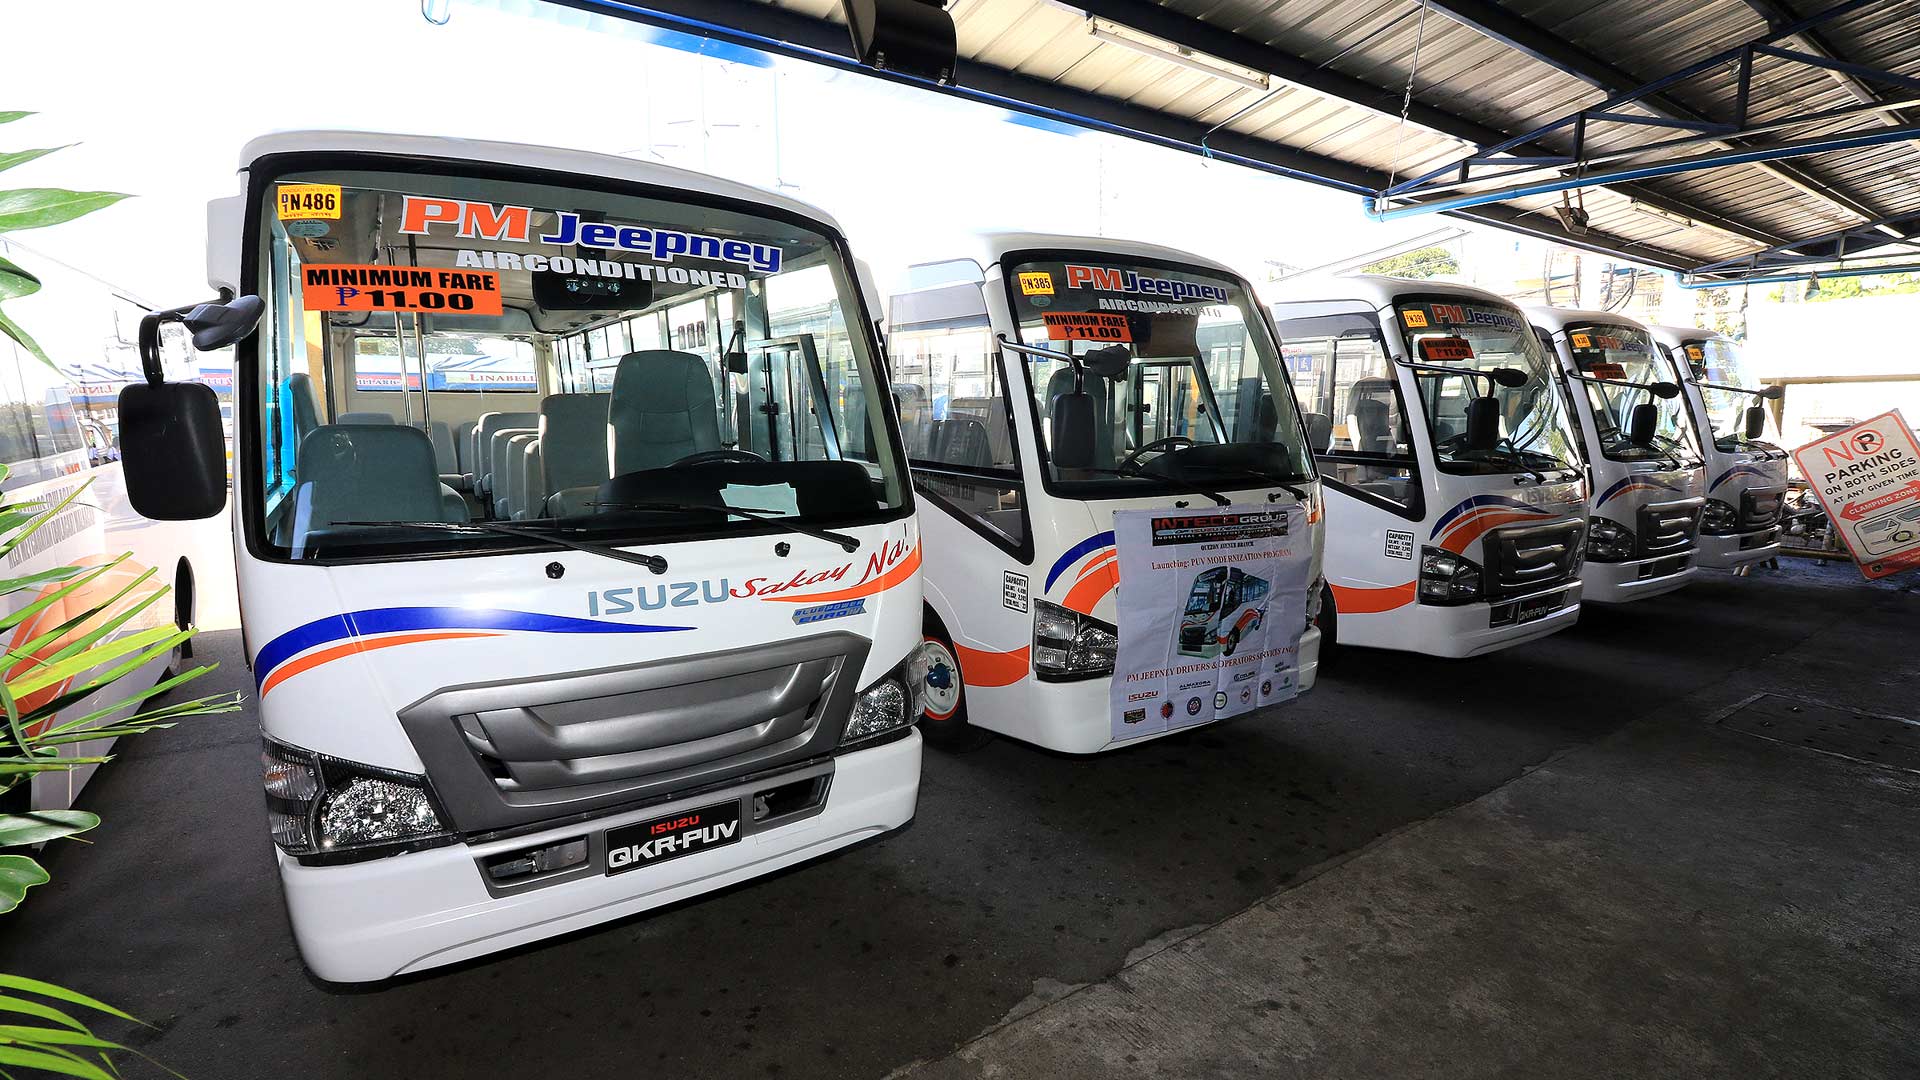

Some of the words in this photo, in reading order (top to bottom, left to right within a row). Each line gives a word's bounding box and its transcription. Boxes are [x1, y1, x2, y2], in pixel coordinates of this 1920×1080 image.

[399, 195, 533, 242] PM
[540, 211, 783, 274] Jeepney
[307, 269, 432, 288] MINIMUM
[439, 272, 495, 290] FARE
[456, 250, 746, 288] AIRCONDITIONED
[1065, 264, 1124, 290] PM
[1124, 271, 1229, 304] Jeepney
[1045, 315, 1099, 327] MINIMUM
[1101, 317, 1126, 328] FARE
[1430, 304, 1465, 324] PM
[1825, 448, 1902, 483] PARKING
[1825, 484, 1842, 495] ON
[1846, 471, 1876, 488] BOTH
[1881, 457, 1916, 475] SIDES
[1833, 494, 1845, 504] AT
[1847, 487, 1866, 501] ANY
[1869, 478, 1895, 492] GIVEN
[1896, 469, 1919, 481] TIME
[1849, 495, 1894, 515] CLAMPING
[1895, 487, 1919, 500] ZONE
[1239, 513, 1288, 524] GROUP
[1191, 557, 1206, 566] PUV
[1207, 552, 1263, 565] MODERNIZATION
[588, 579, 730, 616] ISUZU
[730, 562, 851, 598] Sakay
[1126, 673, 1139, 682] PM
[1140, 667, 1175, 680] JEEPNEY
[1176, 662, 1210, 675] DRIVERS
[1219, 654, 1255, 668] OPERATORS
[1128, 690, 1158, 700] ISUZU
[651, 815, 700, 835] ISUZU
[608, 819, 738, 868] QKR-PUV
